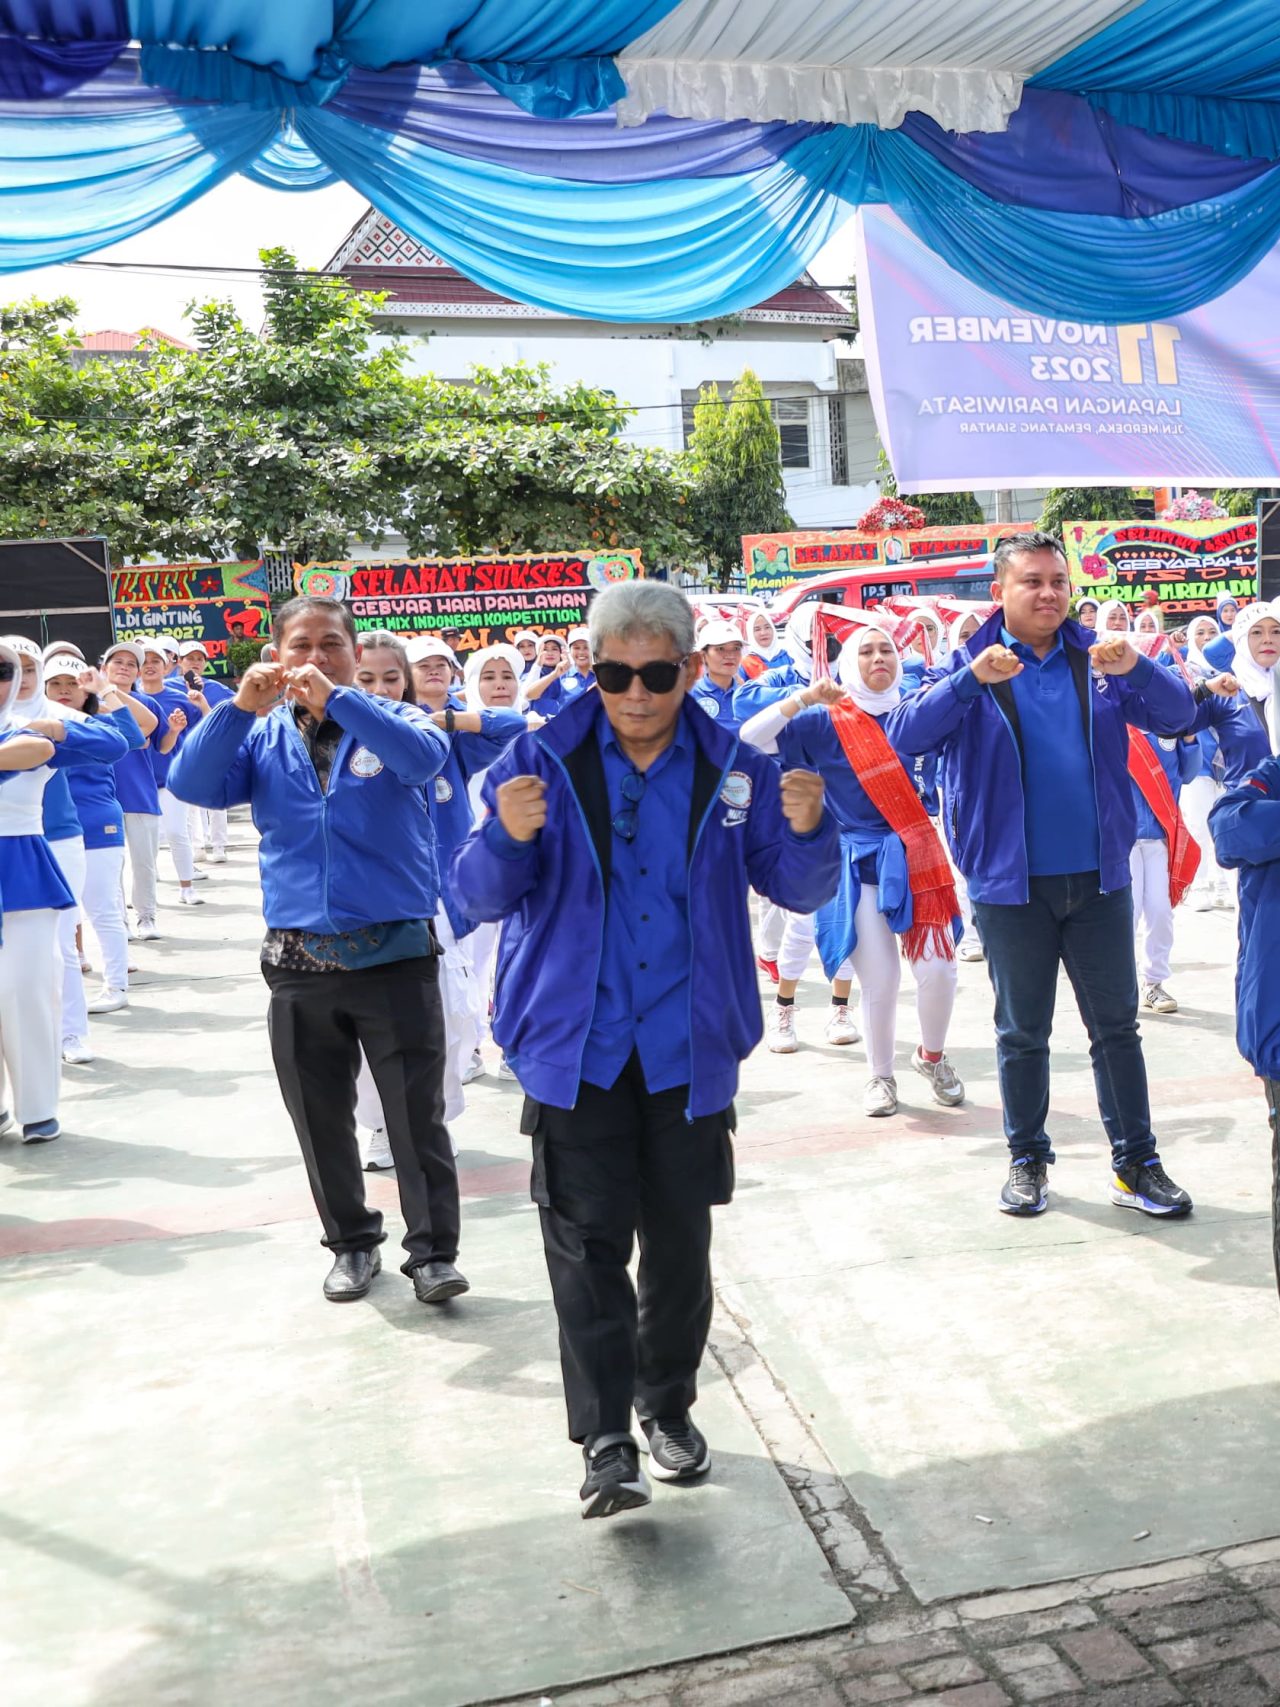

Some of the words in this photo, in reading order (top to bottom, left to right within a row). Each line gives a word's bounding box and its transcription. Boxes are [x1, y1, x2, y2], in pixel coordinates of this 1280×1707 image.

[1116, 558, 1201, 571] GEBYAR
[1201, 556, 1257, 568] PAHL
[352, 563, 471, 598] SELAMAT
[474, 561, 584, 591] SUKSES
[351, 600, 432, 617] GEBYAR
[437, 597, 482, 614] HARI
[484, 592, 587, 612] PAHLAWAN
[143, 610, 203, 627] GINTING
[386, 616, 410, 631] MIX
[413, 613, 483, 629] INDONESIA
[484, 609, 581, 627] KOMPETITION
